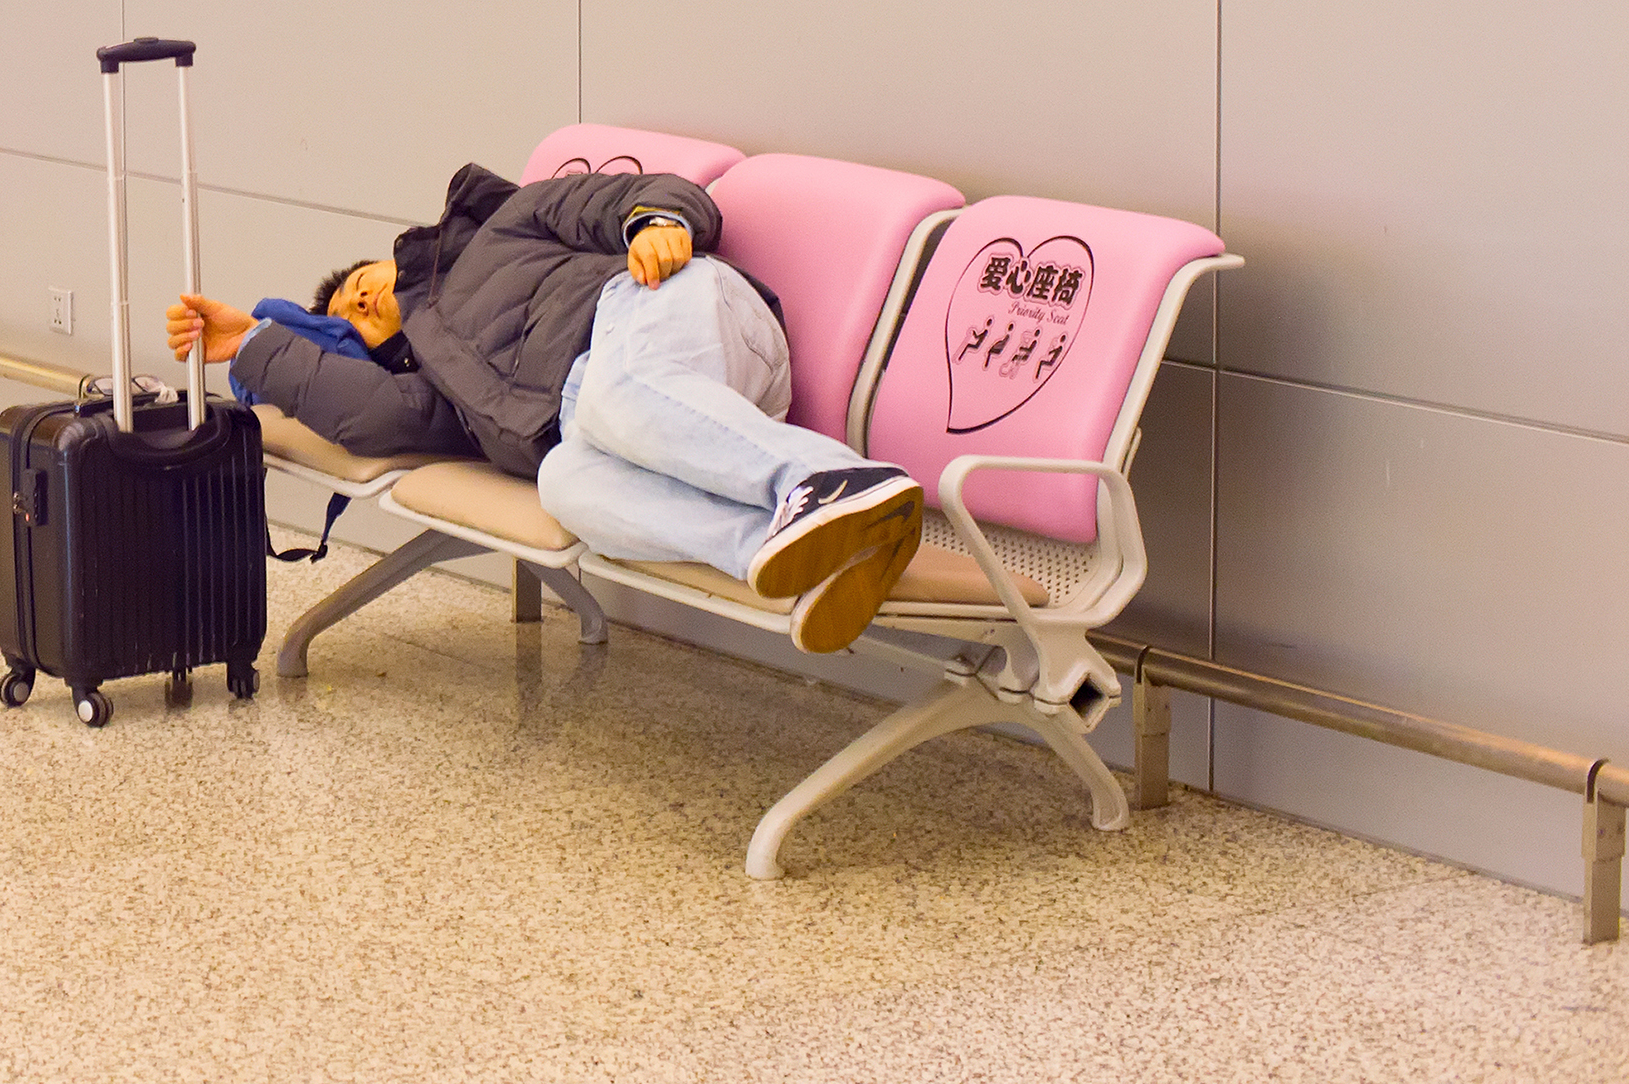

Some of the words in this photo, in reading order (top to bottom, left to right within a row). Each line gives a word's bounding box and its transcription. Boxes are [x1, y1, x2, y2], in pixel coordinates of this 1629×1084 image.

[980, 256, 1084, 306] 爱心座椅
[1008, 301, 1046, 324] Priority
[1046, 307, 1070, 326] Seat
